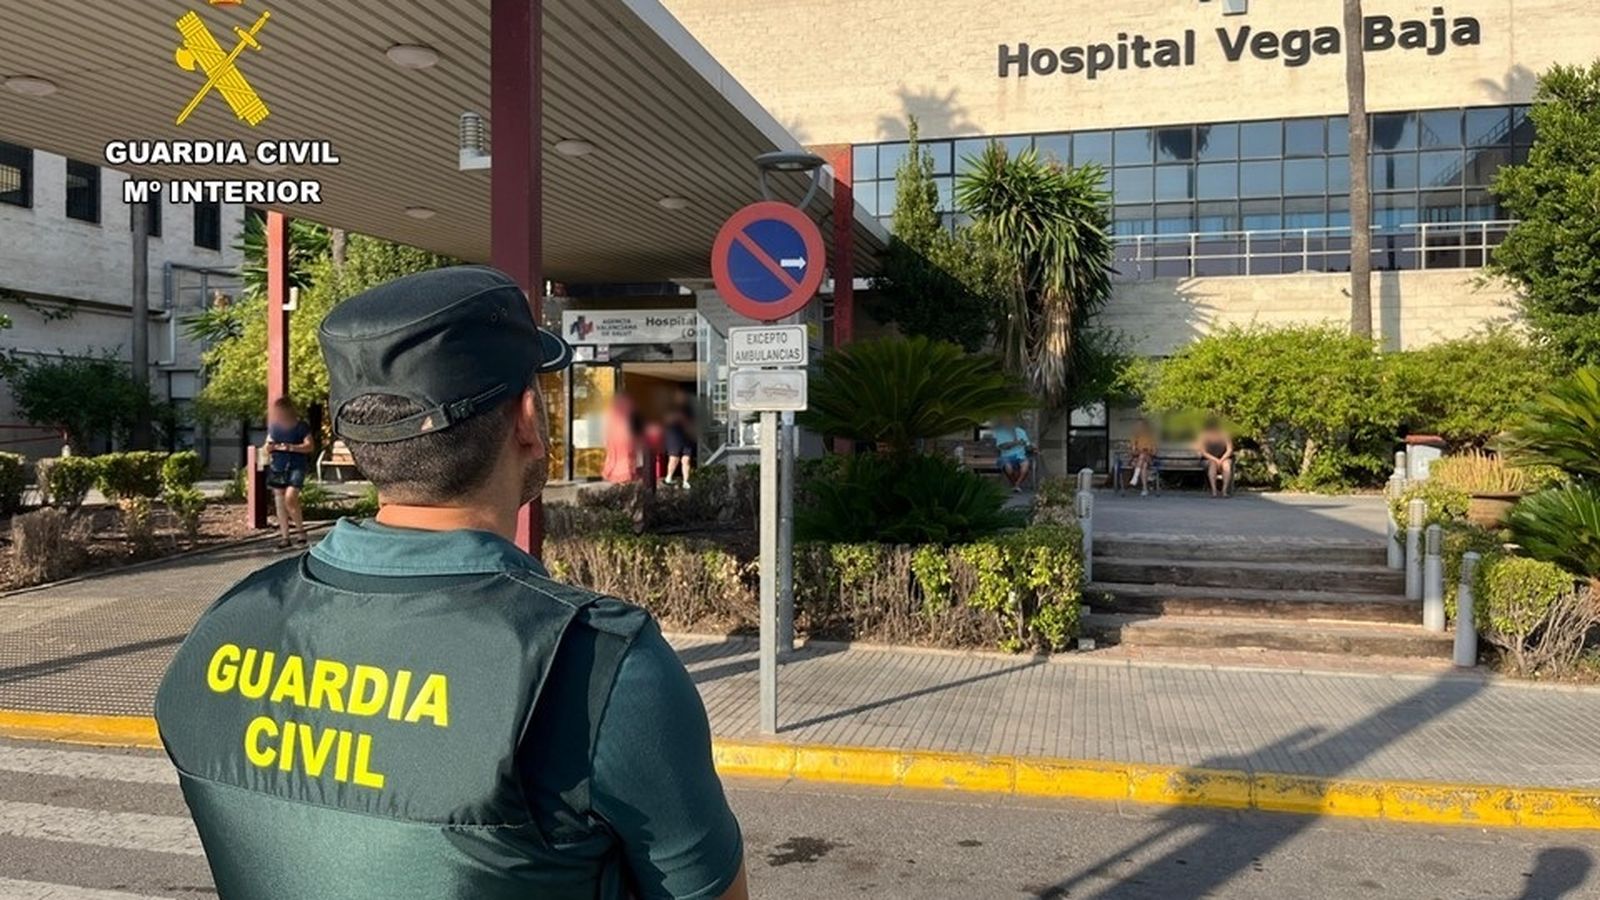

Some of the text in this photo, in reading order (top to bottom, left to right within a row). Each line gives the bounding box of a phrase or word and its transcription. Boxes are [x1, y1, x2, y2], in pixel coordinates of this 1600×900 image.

[998, 7, 1481, 79] Hospital Vega Baja
[645, 316, 697, 328] Hospital
[746, 332, 787, 344] EXCEPTO
[735, 348, 801, 361] AMBULANCIAS
[207, 643, 448, 727] GUARDIA
[244, 716, 385, 789] CIVIL
